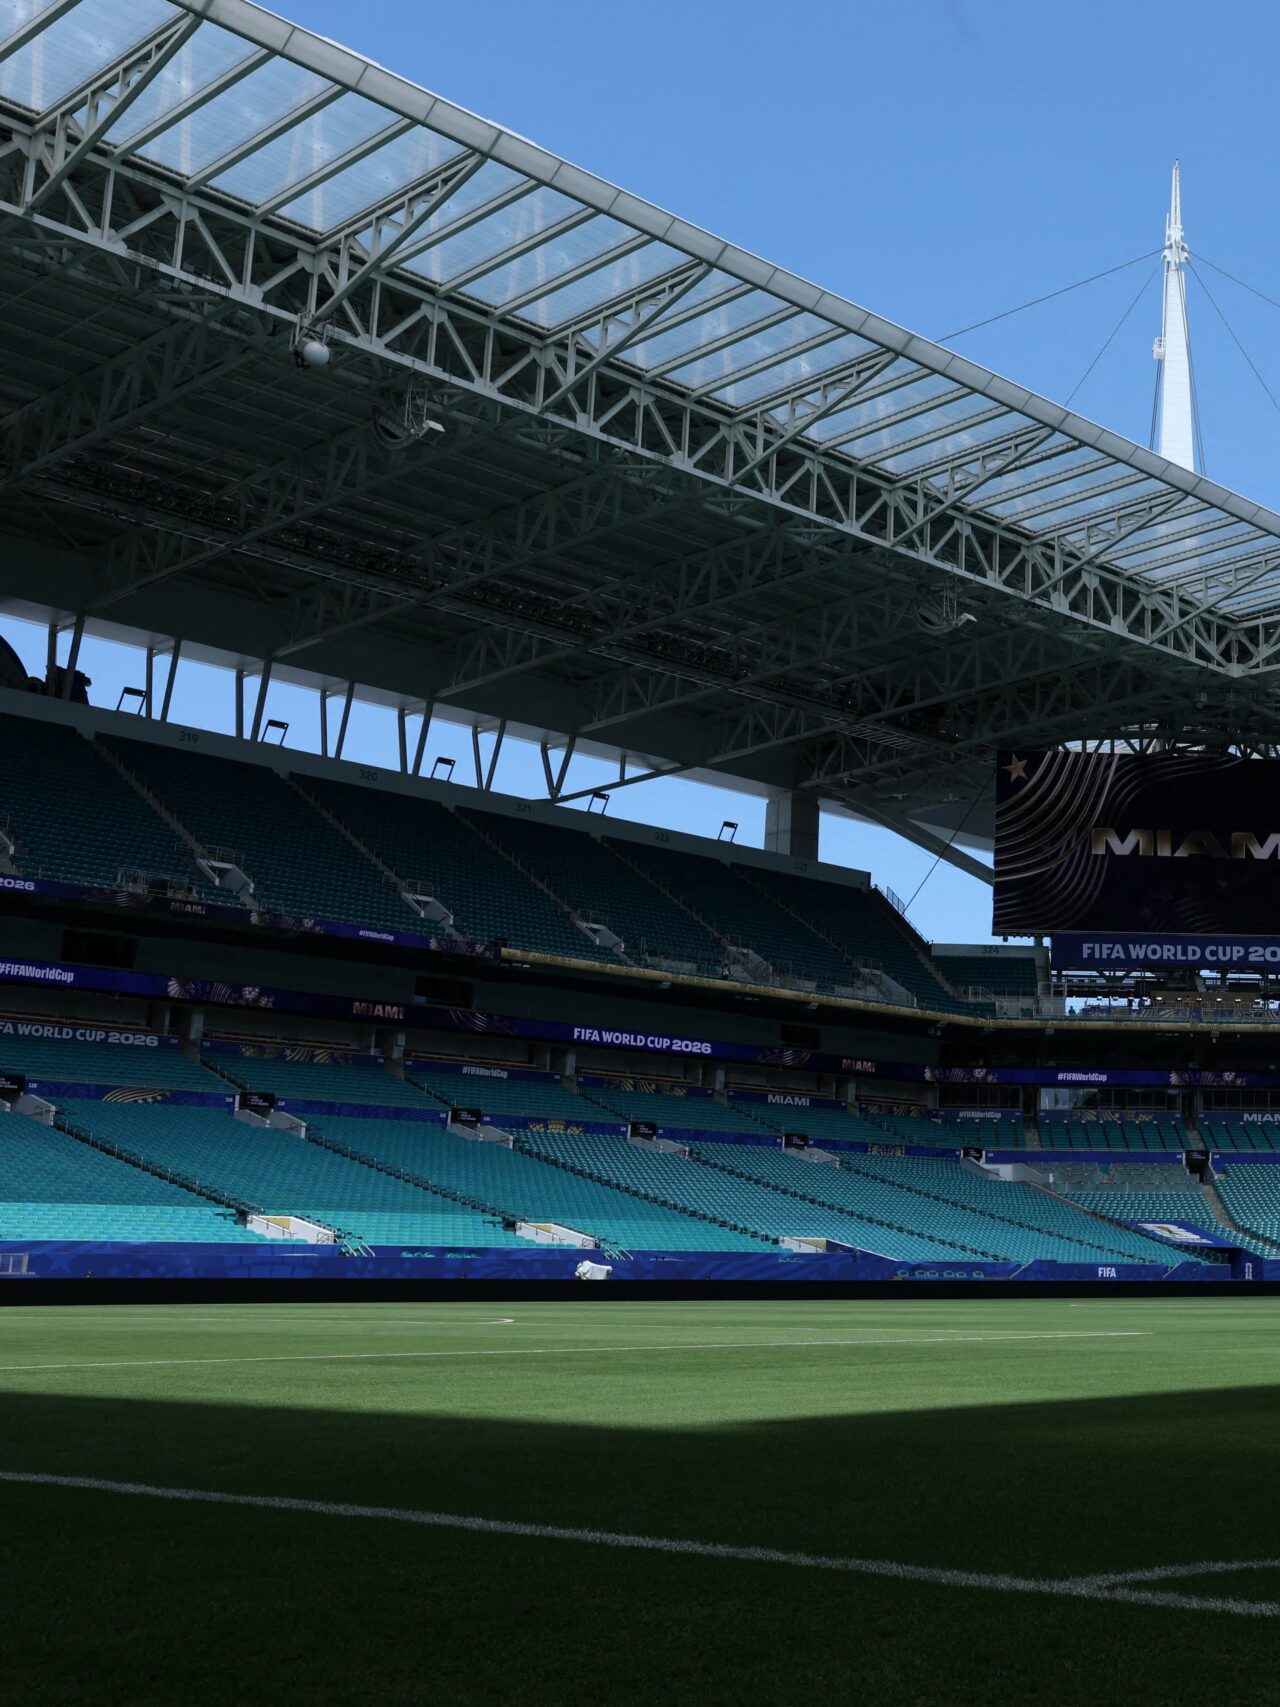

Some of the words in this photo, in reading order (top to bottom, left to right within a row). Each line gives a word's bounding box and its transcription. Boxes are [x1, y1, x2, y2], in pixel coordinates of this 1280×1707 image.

[178, 731, 199, 744] 319
[359, 769, 378, 782] 320
[170, 901, 206, 915] MIAMI
[1083, 943, 1125, 960] FIFA
[1129, 944, 1200, 961] WORLD
[1205, 946, 1244, 962] CUP
[0, 962, 75, 983] #FIFAWorldCup
[353, 1001, 405, 1020] MIAMI
[17, 1023, 73, 1039] WORLD
[76, 1028, 106, 1043] CUP
[107, 1032, 159, 1047] 2026
[573, 1027, 600, 1042] FIFA
[602, 1030, 645, 1047] WORLD
[647, 1036, 670, 1049] CUP
[672, 1041, 712, 1054] 2026
[841, 1058, 876, 1072] MIAMI
[768, 1094, 810, 1107] MIAMI
[1098, 1267, 1117, 1278] FIFA
